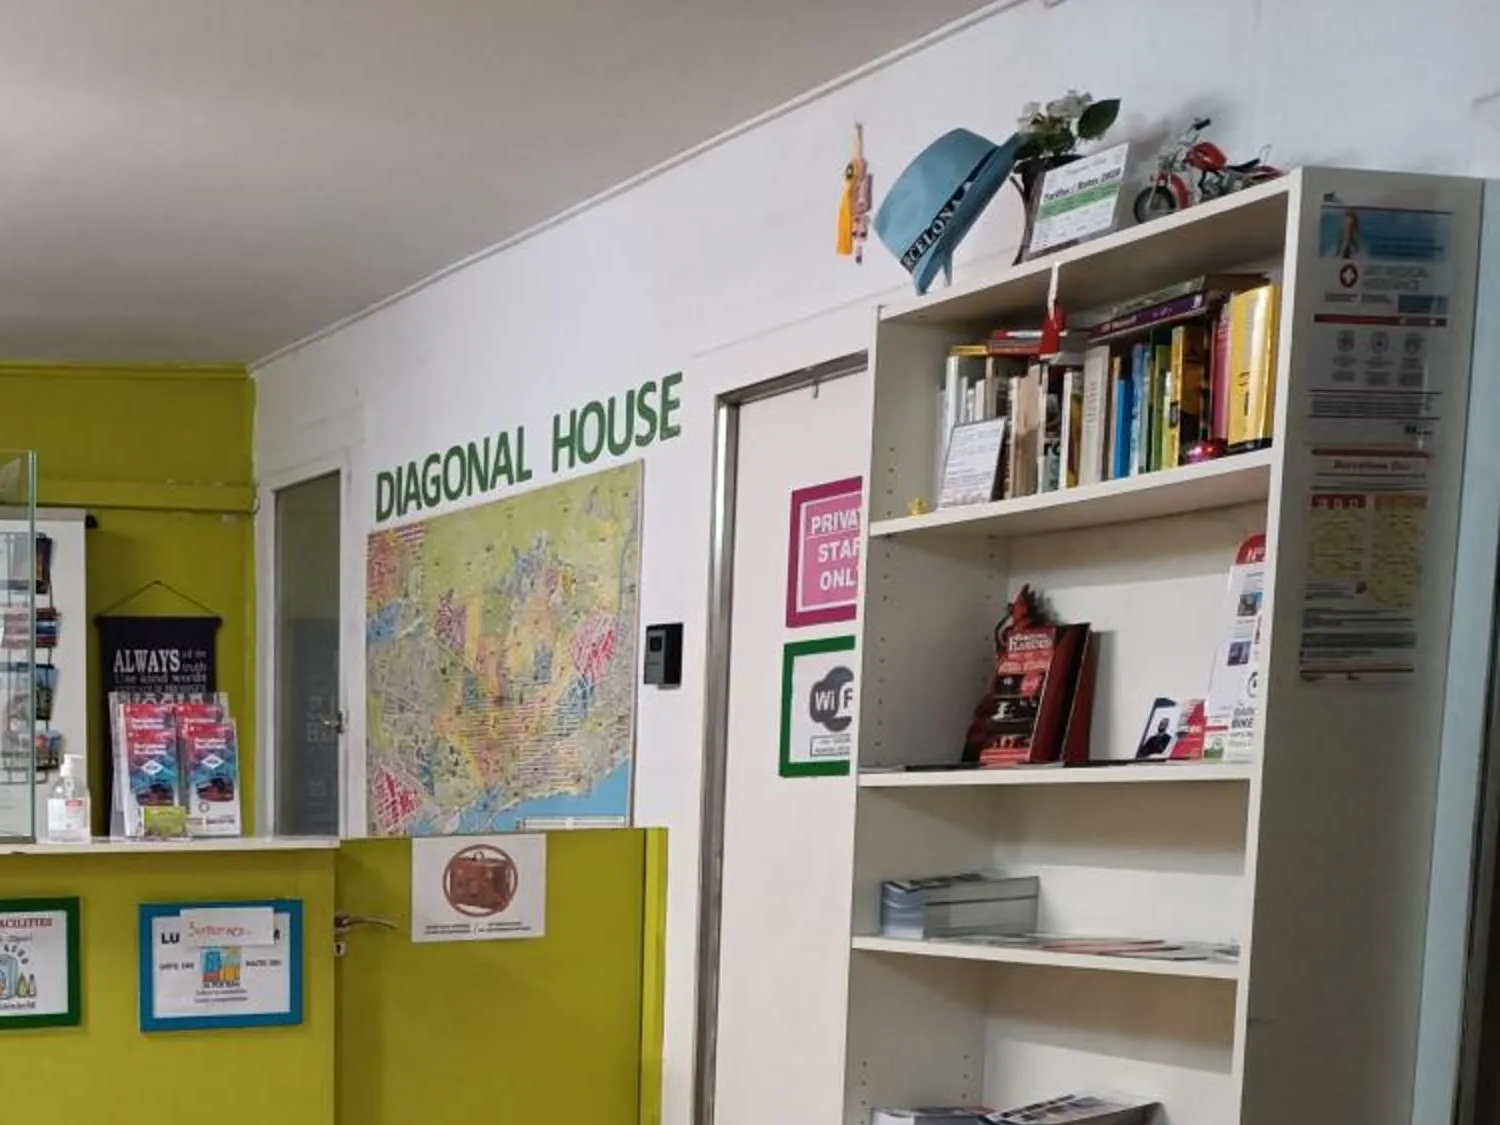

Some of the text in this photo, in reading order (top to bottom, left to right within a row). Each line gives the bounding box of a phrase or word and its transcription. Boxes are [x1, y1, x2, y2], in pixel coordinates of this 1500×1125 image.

[376, 371, 683, 523] DIAGONAL HOUSE
[811, 507, 860, 535] PRIVA
[818, 536, 861, 563] STAF
[820, 566, 859, 591] ONL
[113, 648, 181, 673] ALWAYS
